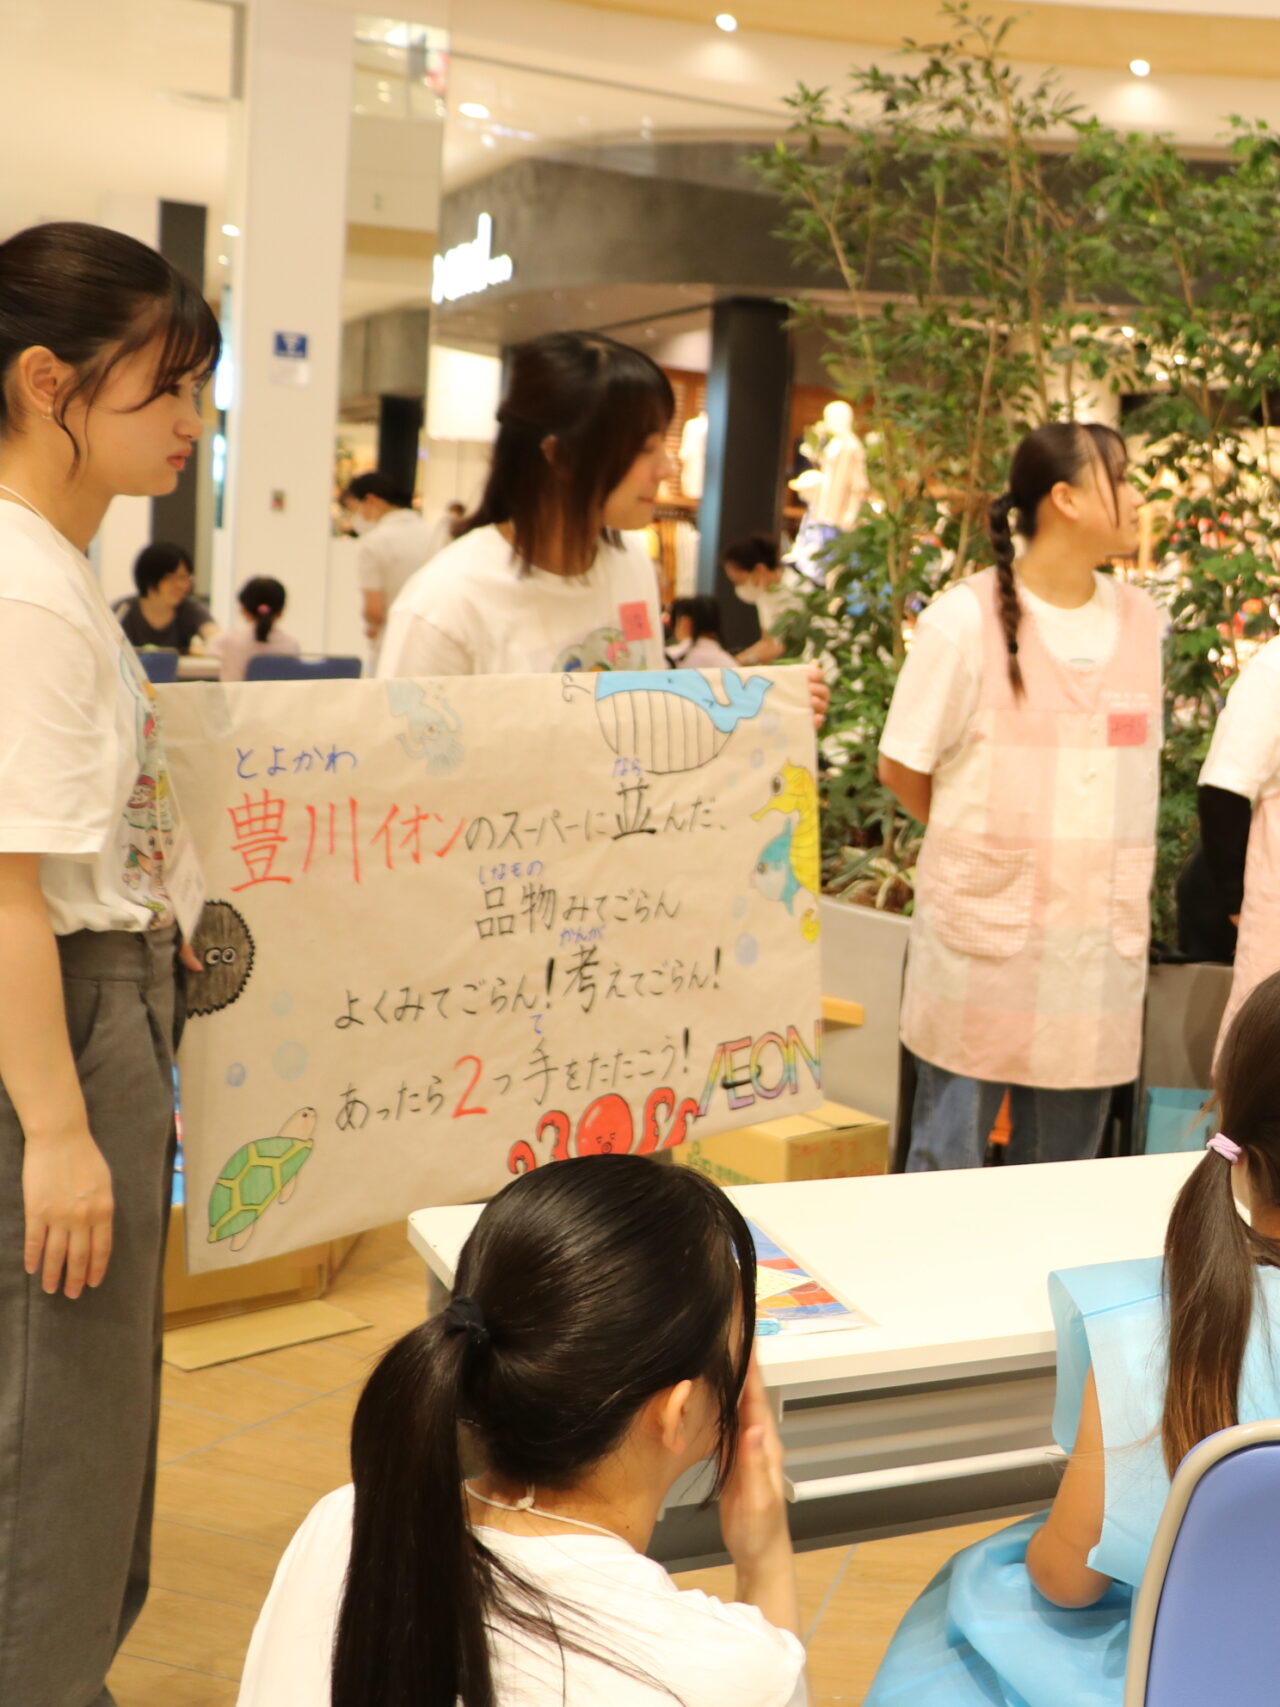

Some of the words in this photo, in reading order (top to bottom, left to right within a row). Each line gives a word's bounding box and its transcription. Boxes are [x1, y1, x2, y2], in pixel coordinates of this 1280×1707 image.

[235, 745, 357, 779] とよかわ
[479, 860, 544, 885] しなもの
[475, 882, 680, 939] 品物みてごらん
[530, 1014, 545, 1035] て
